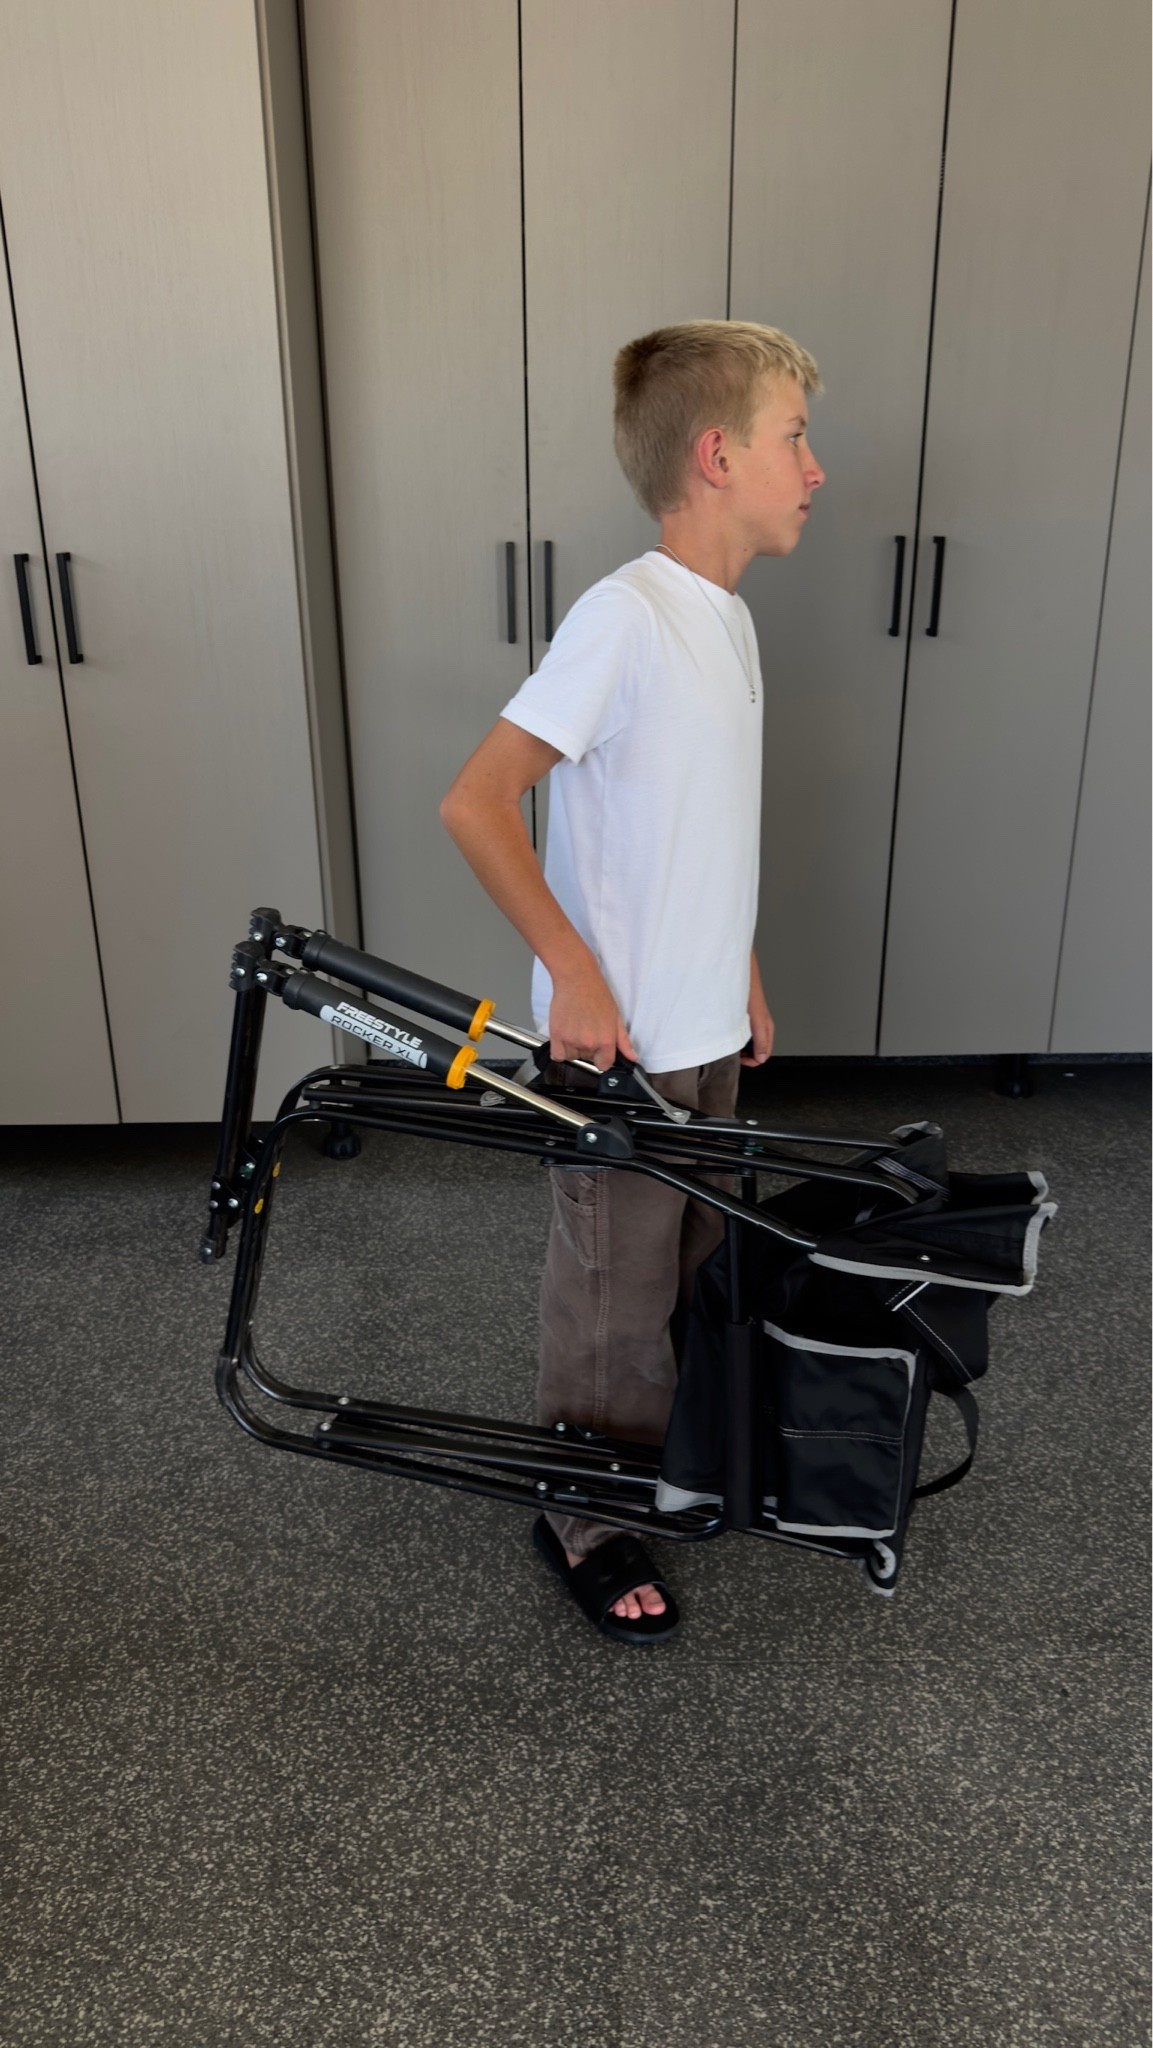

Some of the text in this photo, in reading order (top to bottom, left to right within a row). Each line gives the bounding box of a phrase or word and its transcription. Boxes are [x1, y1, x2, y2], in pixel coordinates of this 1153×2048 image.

[331, 1015, 414, 1061] ROCKER XL
[336, 1001, 423, 1048] FREESTYLE
